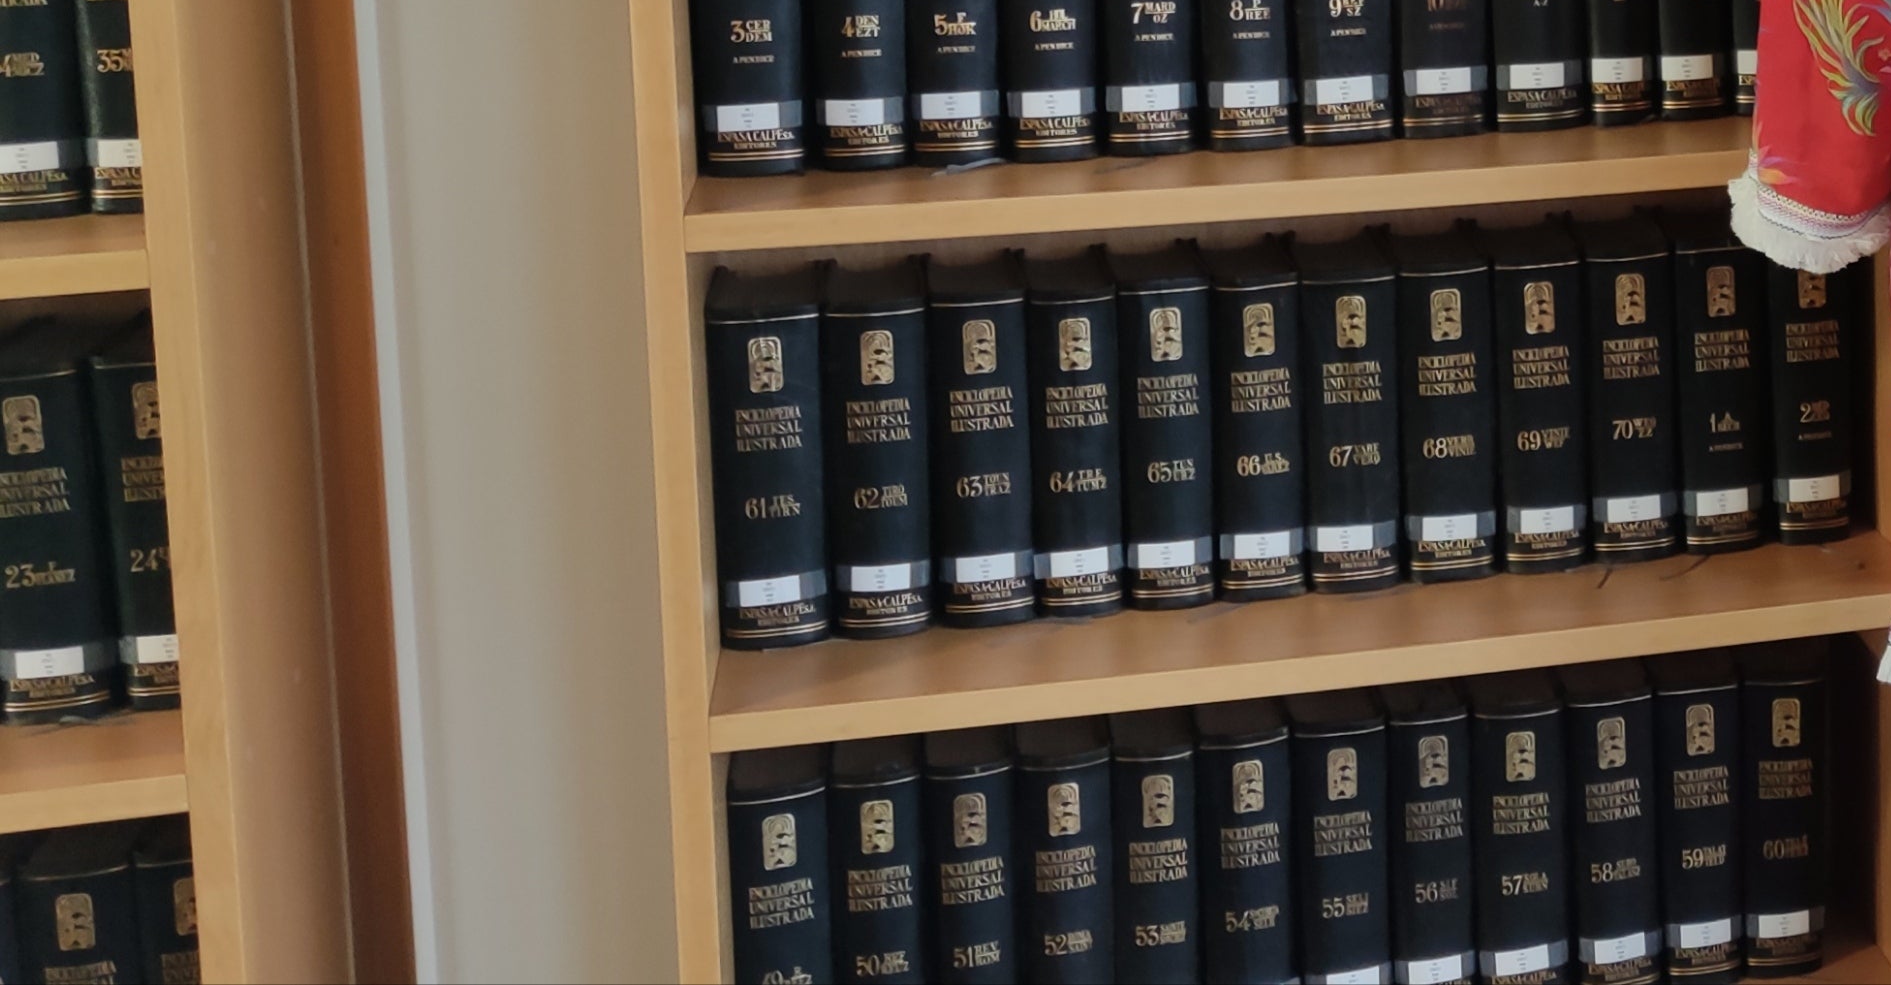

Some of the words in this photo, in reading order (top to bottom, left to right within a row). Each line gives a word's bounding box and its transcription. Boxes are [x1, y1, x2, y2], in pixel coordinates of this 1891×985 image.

[1131, 3, 1144, 24] 7
[1230, 0, 1244, 20] 8
[730, 20, 745, 43] 3
[842, 16, 855, 37] 4
[934, 14, 948, 36] 5
[1030, 11, 1041, 32] 6
[97, 49, 123, 72] 35
[1518, 430, 1541, 451] 69
[1612, 420, 1633, 440] 70
[1329, 445, 1353, 466] 67
[1423, 438, 1446, 458] 68
[1148, 461, 1172, 483] 65
[1237, 456, 1261, 476] 66
[957, 476, 983, 498] 63
[1050, 471, 1075, 493] 64
[745, 497, 767, 519] 61
[854, 488, 880, 509] 62
[5, 565, 34, 588] 23
[1682, 848, 1704, 869] 59
[1592, 863, 1613, 882] 58
[1416, 883, 1438, 903] 56
[1502, 875, 1523, 895] 57
[1322, 898, 1344, 918] 55
[1226, 912, 1251, 933] 54
[1044, 934, 1067, 956] 52
[1135, 926, 1159, 945] 53
[856, 955, 879, 976] 50
[954, 947, 974, 968] 51
